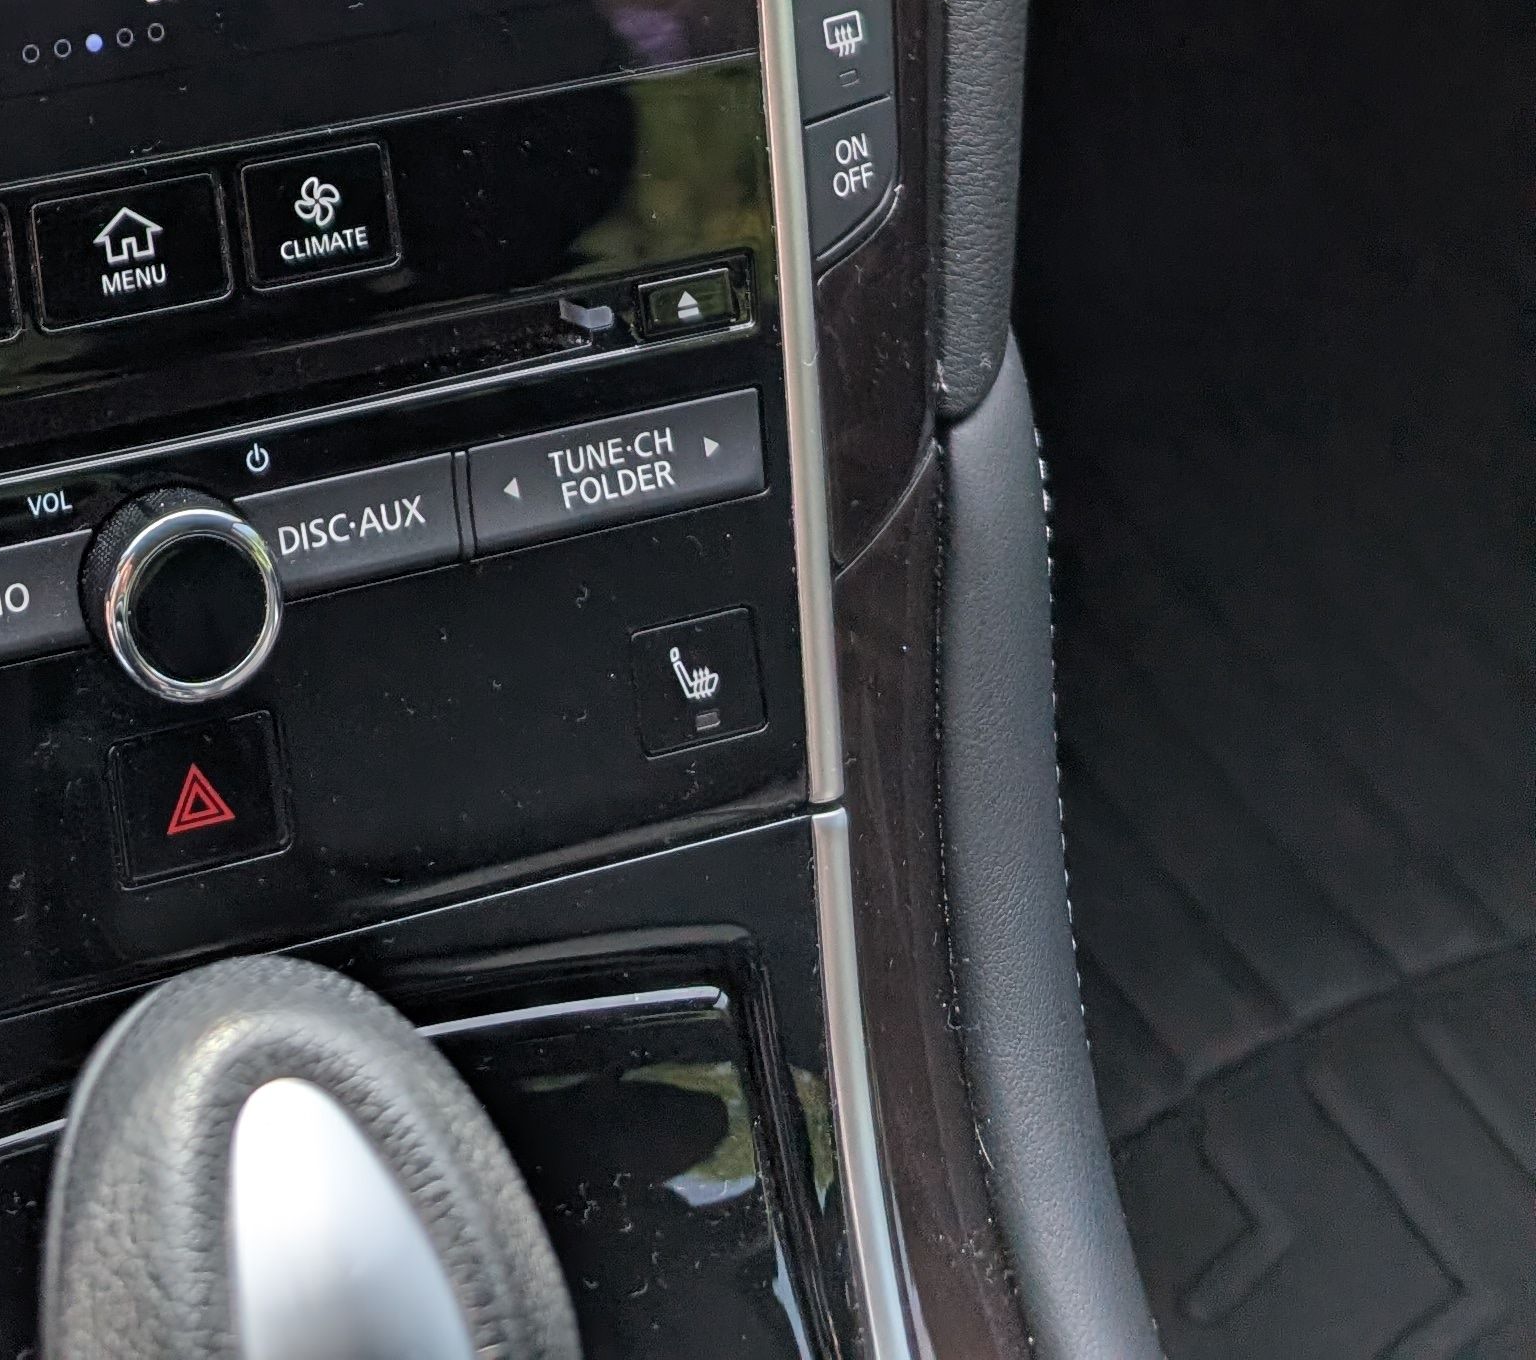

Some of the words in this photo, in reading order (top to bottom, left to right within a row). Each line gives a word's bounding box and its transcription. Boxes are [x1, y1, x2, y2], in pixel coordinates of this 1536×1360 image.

[835, 133, 870, 165] ON
[832, 159, 874, 198] OFF
[280, 225, 369, 262] CLIMATE
[101, 264, 167, 296] MENU
[560, 460, 675, 509] FOLDER
[26, 490, 73, 517] VOL
